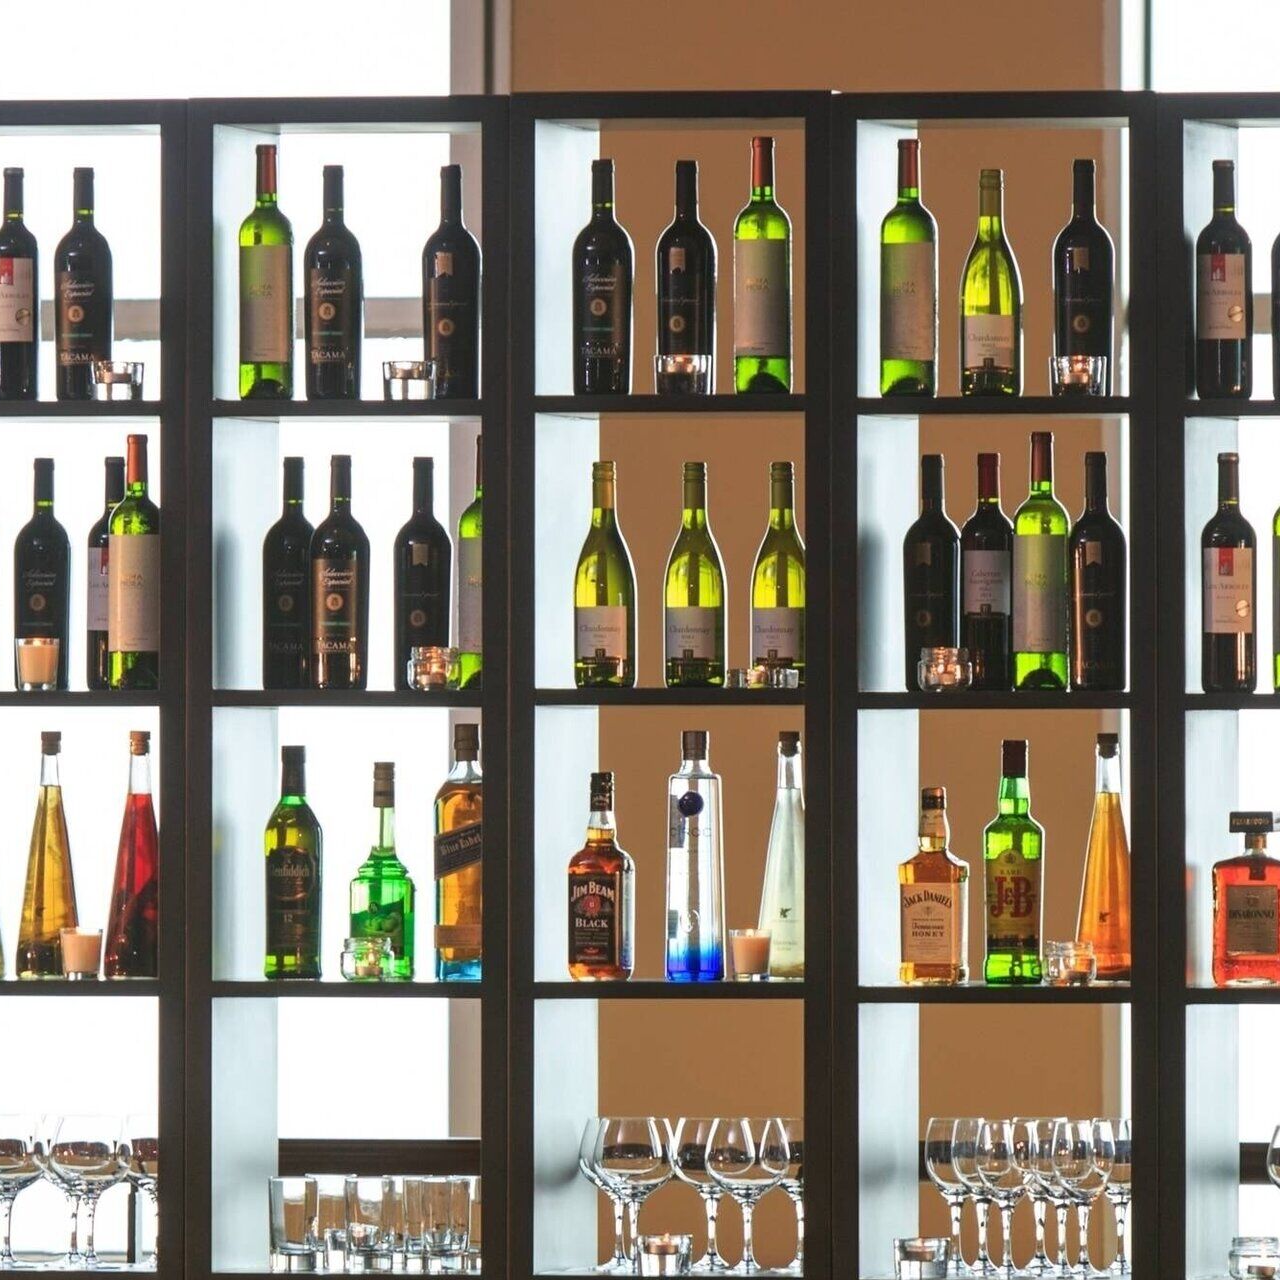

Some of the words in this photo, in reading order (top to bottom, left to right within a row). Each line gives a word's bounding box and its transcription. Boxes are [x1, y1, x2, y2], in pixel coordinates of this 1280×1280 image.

[570, 885, 588, 902] JIM
[588, 881, 616, 903] BEAM
[990, 876, 1034, 918] J&B
[902, 895, 923, 909] JACK
[283, 913, 293, 923] 12
[575, 918, 609, 929] BLACK
